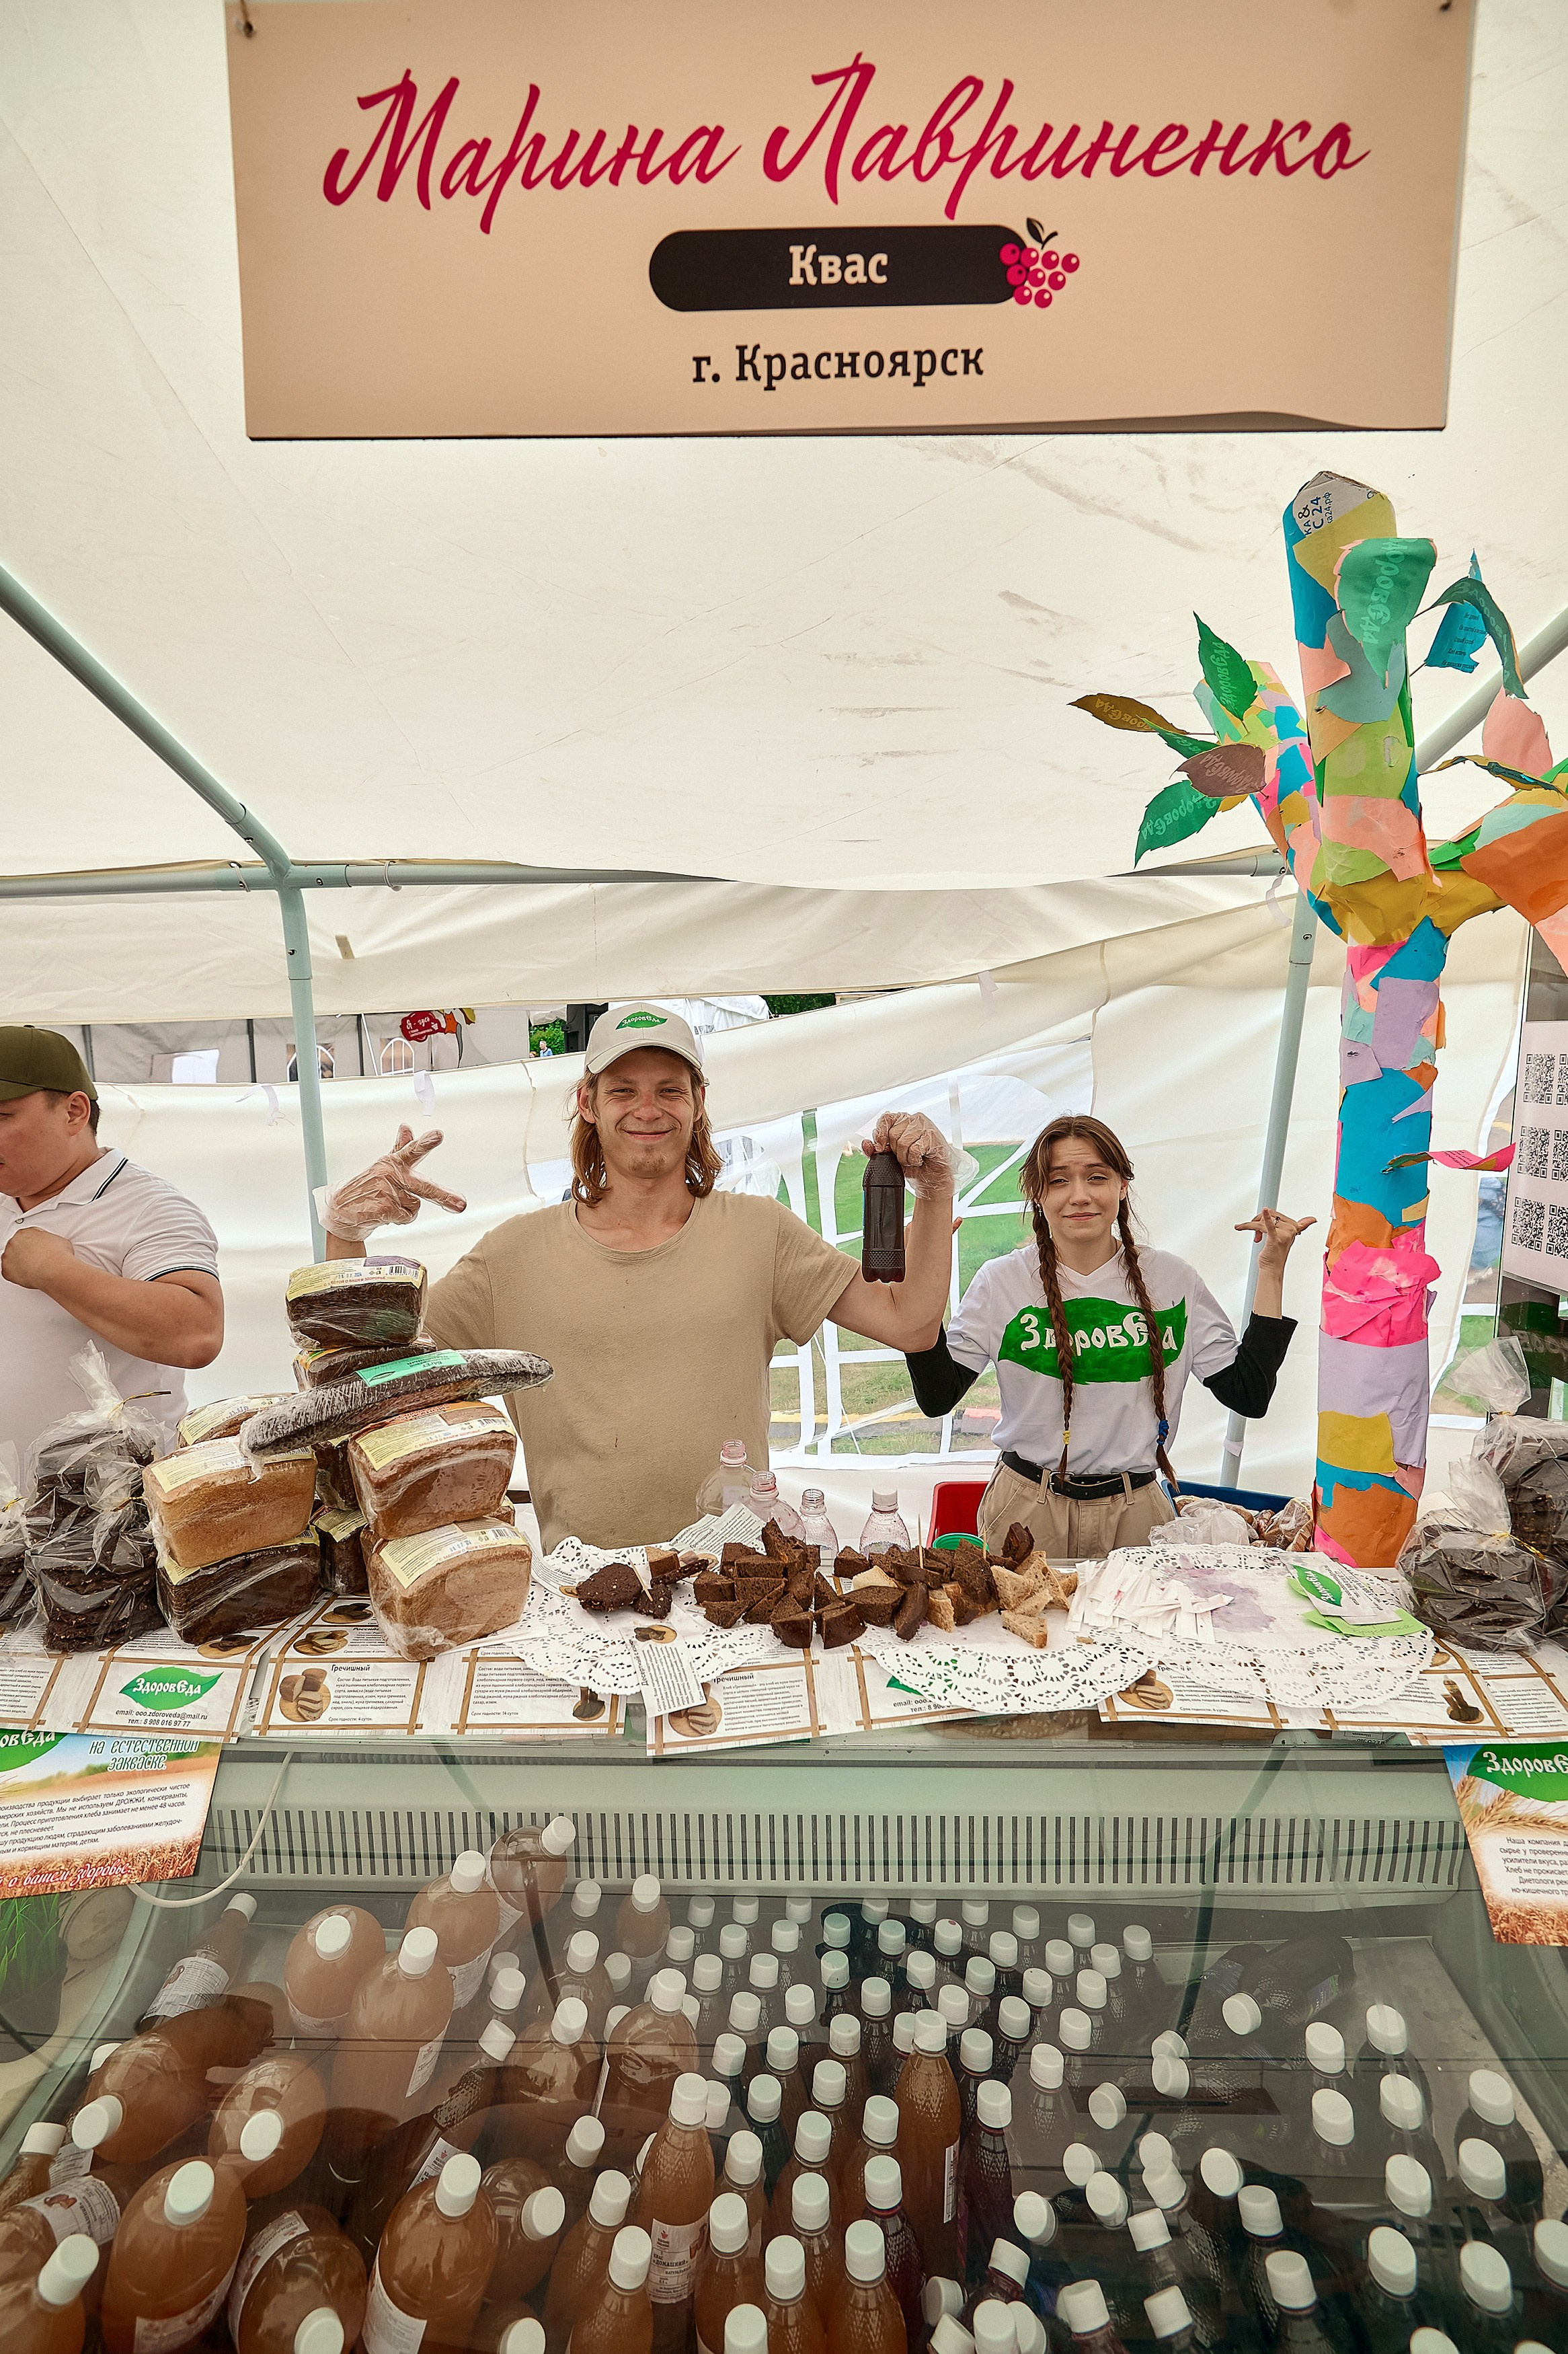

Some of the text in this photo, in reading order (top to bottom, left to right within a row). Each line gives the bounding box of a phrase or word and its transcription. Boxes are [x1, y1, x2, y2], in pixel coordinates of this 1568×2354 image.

[323, 52, 1368, 235] Марина Лавриненко
[789, 244, 888, 286] Квас
[693, 344, 984, 391] г. Красноярск
[1020, 1312, 1178, 1357] ЗдровЕа
[331, 1665, 370, 1673] Гречишный
[132, 1678, 201, 1696] ЗдоровЕда
[135, 1710, 208, 1720] ooo.zdoroveda@mail.ru
[89, 1741, 104, 1754] на
[37, 1799, 70, 1809] продукции
[73, 1794, 101, 1802] выбирает
[126, 1786, 167, 1796] экологически
[78, 1802, 114, 1811] используем
[115, 1796, 145, 1807] ДРОЖЖИ,
[147, 1792, 188, 1802] консерванты,
[38, 1814, 83, 1824] приготовления
[102, 1808, 130, 1816] занимает
[9, 1836, 44, 1846] продукцию
[67, 1827, 105, 1838] страдающим
[106, 1823, 153, 1833] заболеваниями
[154, 1819, 182, 1827] желудоч-
[19, 1826, 54, 1834] плесневеет.
[17, 1844, 50, 1853] кормящим
[51, 1840, 78, 1848] матерям,
[79, 1837, 100, 1846] детям.
[1519, 1876, 1555, 1885] Диетологи
